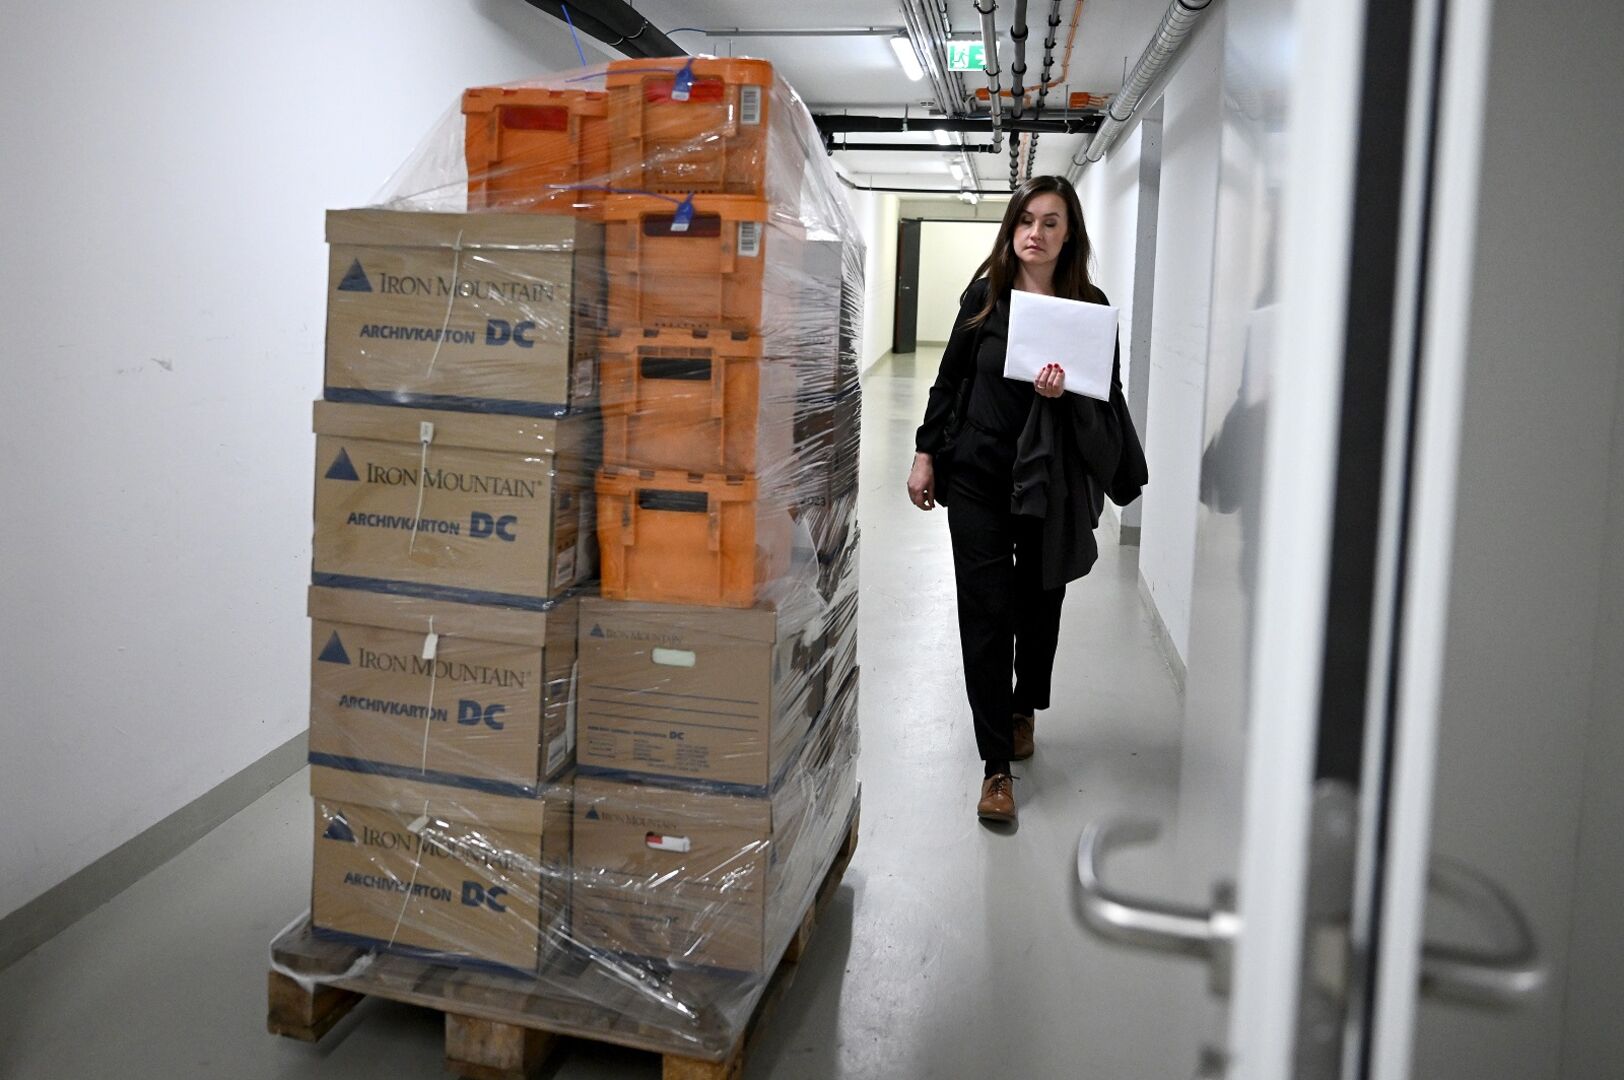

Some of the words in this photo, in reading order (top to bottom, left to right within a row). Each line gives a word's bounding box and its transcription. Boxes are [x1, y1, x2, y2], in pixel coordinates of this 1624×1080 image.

[380, 272, 432, 296] IRON
[359, 324, 476, 344] ARCHIVKARTON
[485, 318, 536, 348] DC
[366, 462, 417, 486] IRON
[346, 511, 460, 536] ARCHIVKARTON
[469, 511, 518, 542] DC
[359, 647, 407, 673] IRON
[339, 694, 448, 721] ARCHIVKARTON
[457, 699, 506, 730] DC
[362, 825, 414, 851] IRON
[461, 880, 508, 913] DC
